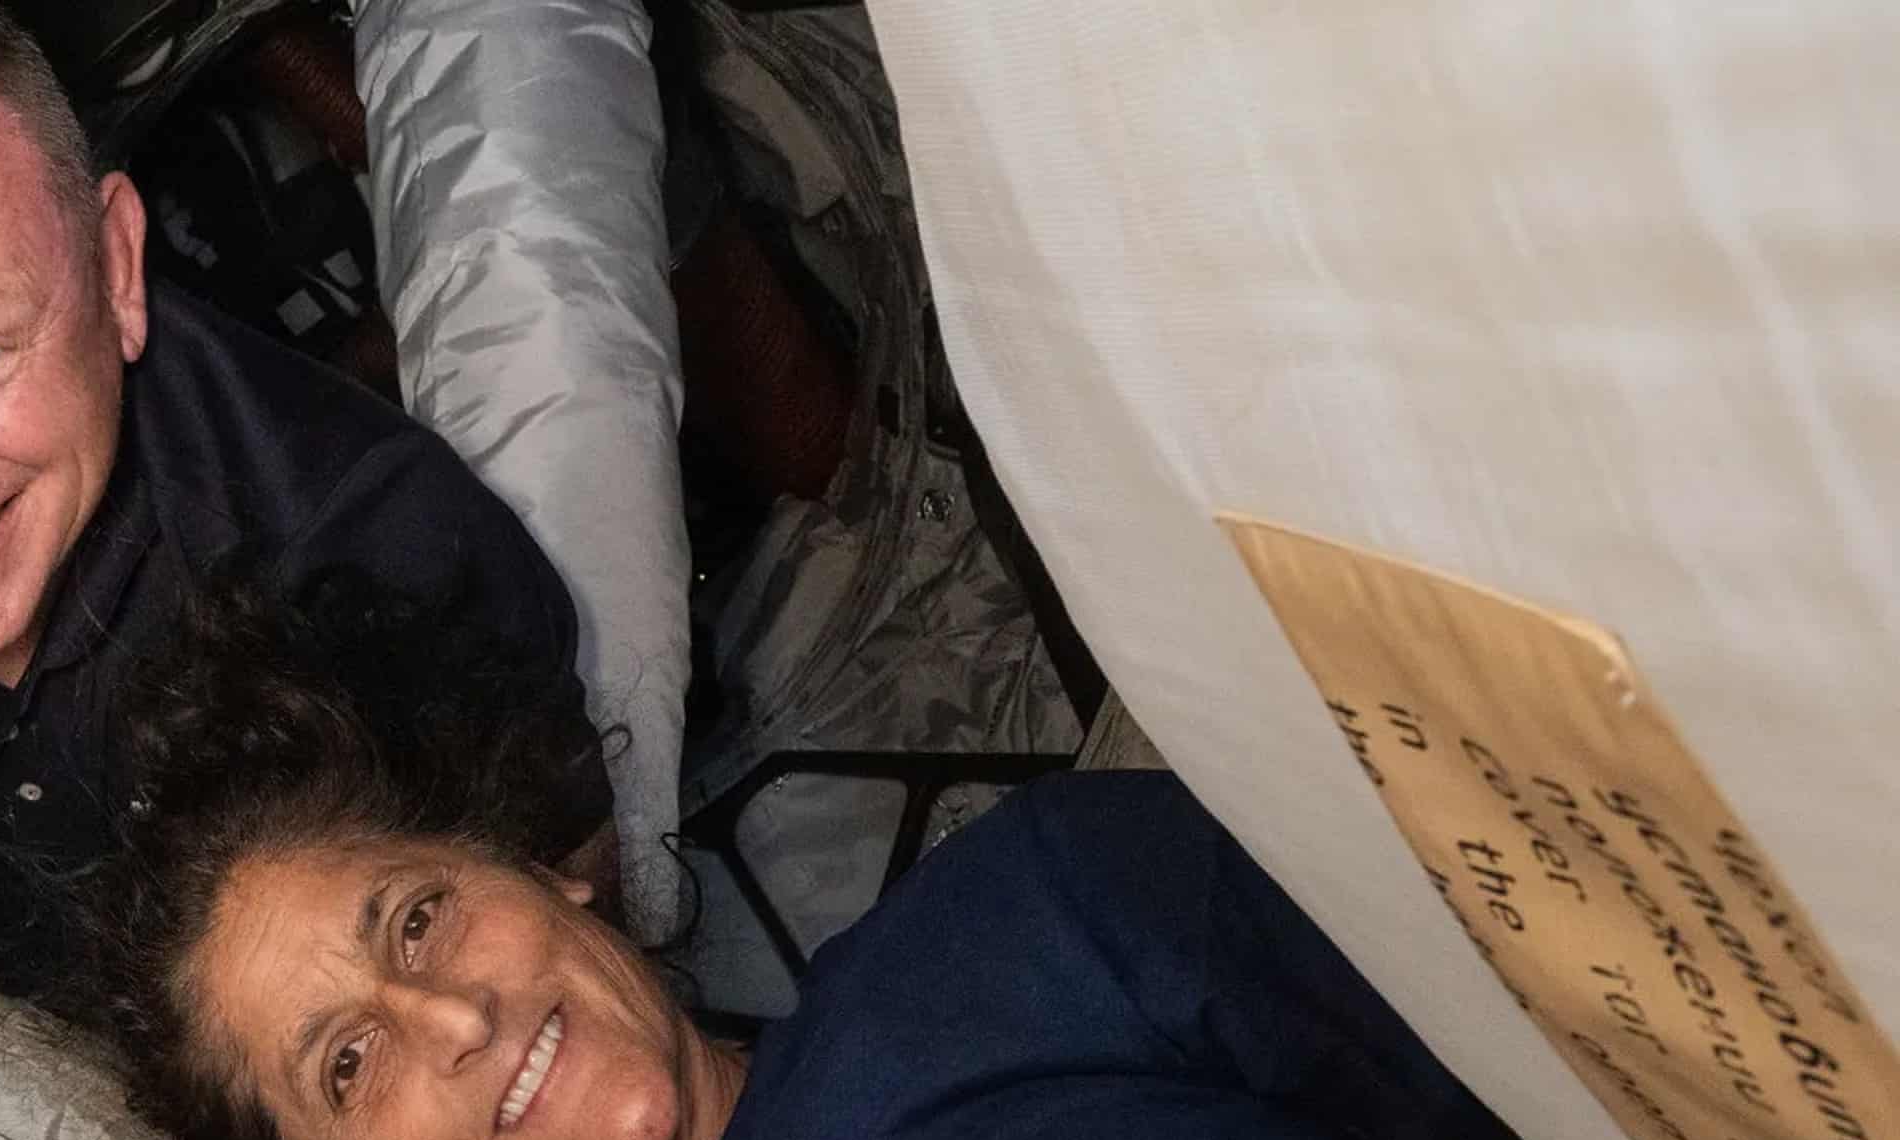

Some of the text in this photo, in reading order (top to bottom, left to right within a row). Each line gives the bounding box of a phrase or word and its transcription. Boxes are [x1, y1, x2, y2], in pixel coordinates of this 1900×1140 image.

[1381, 703, 1427, 751] in
[1457, 840, 1524, 931] the
[1460, 736, 1587, 901] cover
[1532, 775, 1777, 1116] положении
